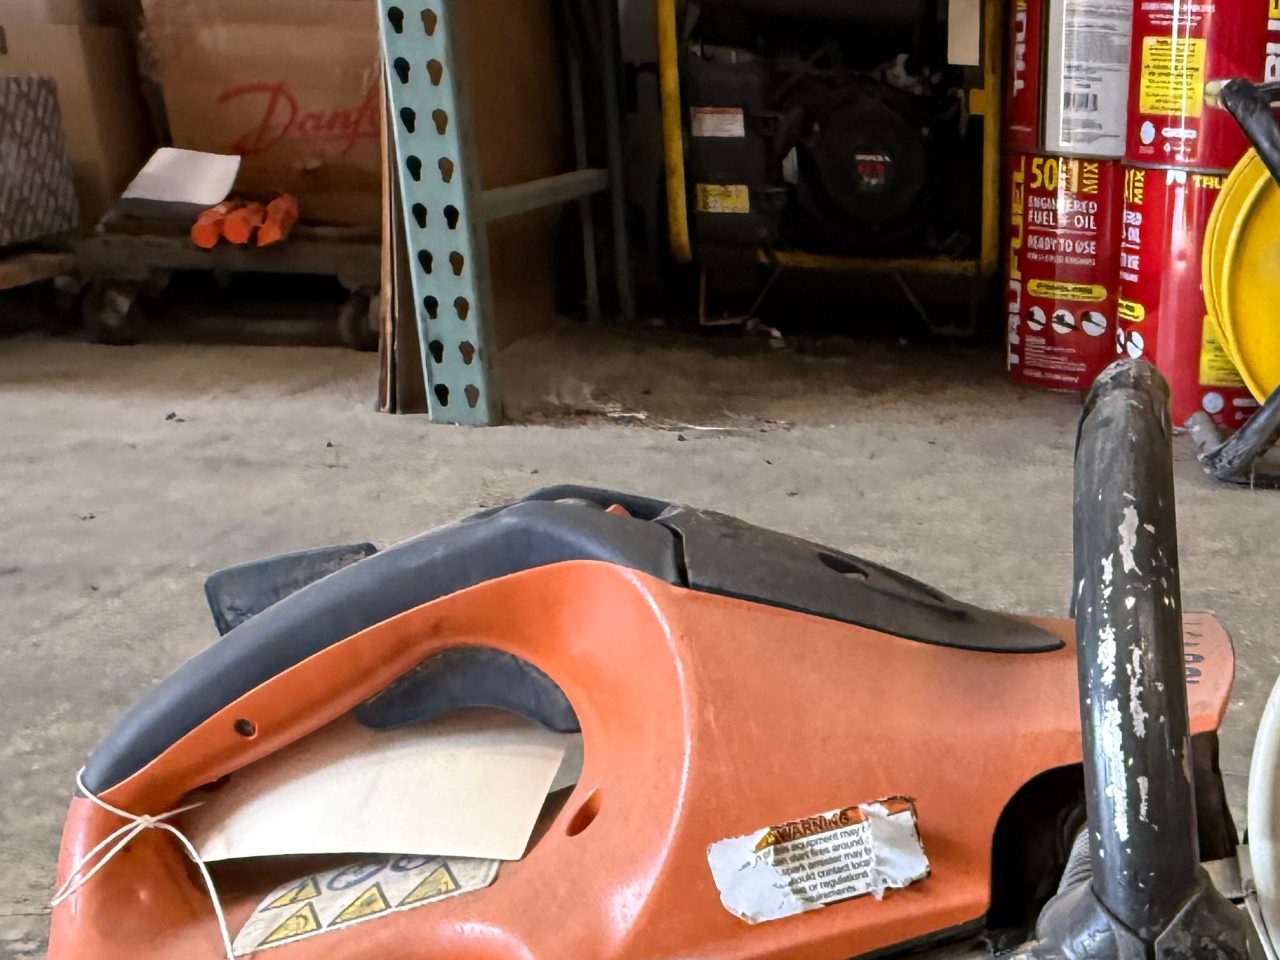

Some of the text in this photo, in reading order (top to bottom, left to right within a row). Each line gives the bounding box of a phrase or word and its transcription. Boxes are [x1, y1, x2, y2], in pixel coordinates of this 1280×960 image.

[1082, 161, 1099, 194] MIX
[1133, 169, 1146, 205] MIX
[1027, 209, 1056, 226] FUEL
[1074, 214, 1097, 230] OIL
[1027, 234, 1097, 255] READY TO USE
[1008, 155, 1026, 371] TRUFUEL
[774, 812, 850, 842] WARNING
[790, 833, 840, 853] equipment
[839, 826, 862, 841] may
[831, 837, 865, 854] around
[843, 850, 864, 863] may
[816, 860, 851, 879] contact
[808, 882, 819, 893] or
